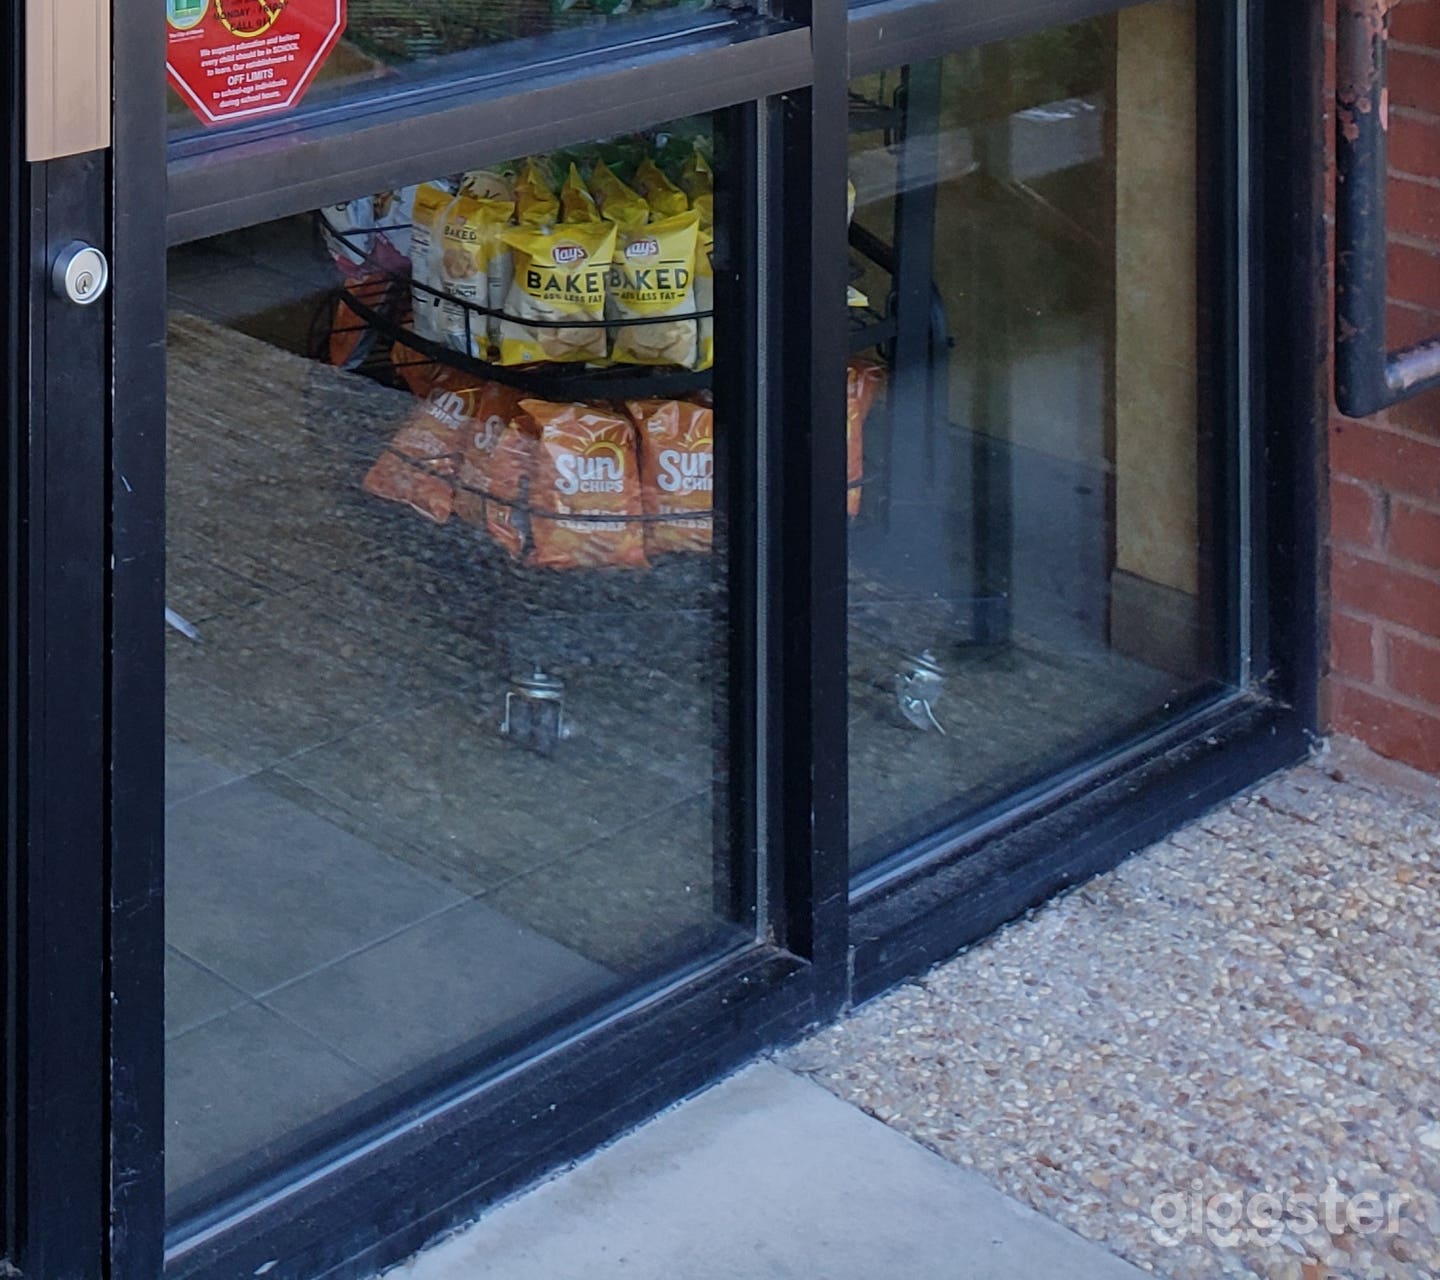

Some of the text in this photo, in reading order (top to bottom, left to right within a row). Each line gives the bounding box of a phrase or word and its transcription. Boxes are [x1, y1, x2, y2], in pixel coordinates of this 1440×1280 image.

[227, 68, 274, 86] OFF LIMITS
[444, 225, 477, 241] BAKED
[611, 269, 689, 291] BAKED
[660, 290, 676, 300] FAT
[555, 450, 624, 496] Sun
[580, 479, 624, 493] CHIPS
